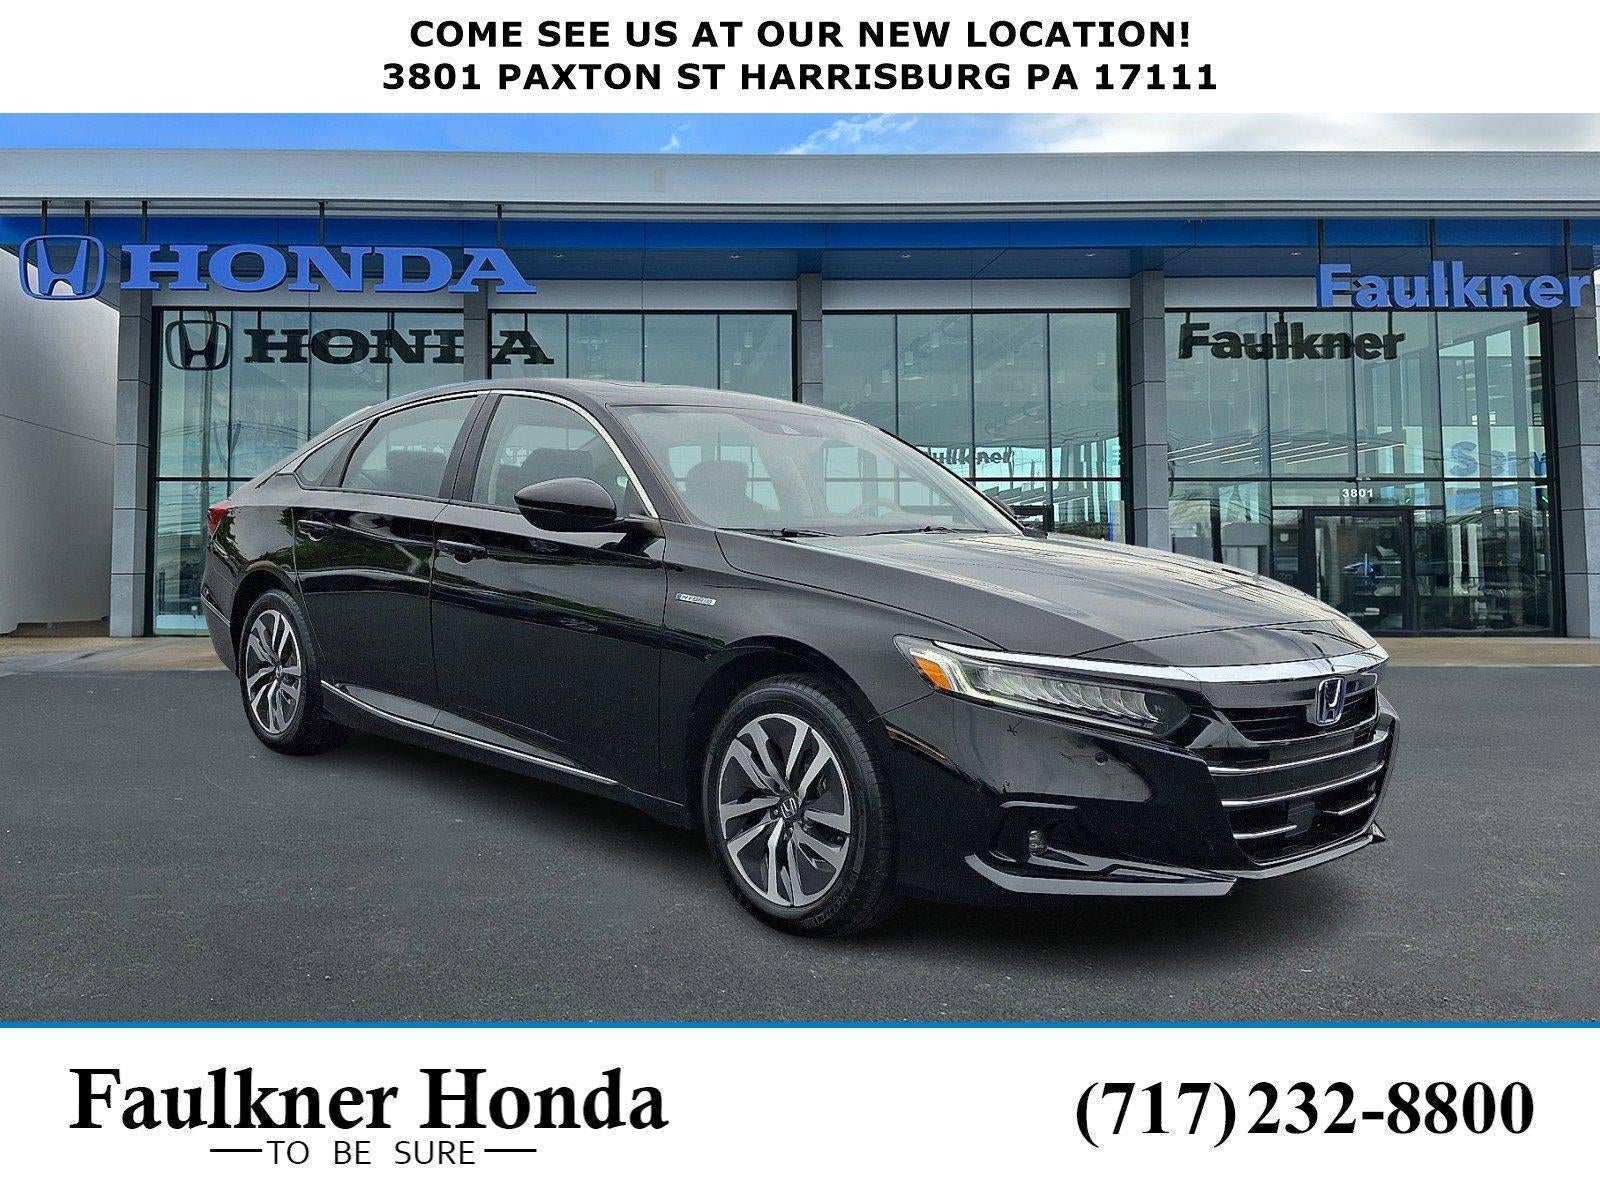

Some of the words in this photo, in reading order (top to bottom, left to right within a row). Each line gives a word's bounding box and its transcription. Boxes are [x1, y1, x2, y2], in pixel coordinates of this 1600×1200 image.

[121, 244, 537, 294] HONDA
[1317, 260, 1591, 309] Faulkner
[1178, 322, 1406, 360] Faulkner
[1342, 488, 1374, 498] 3801
